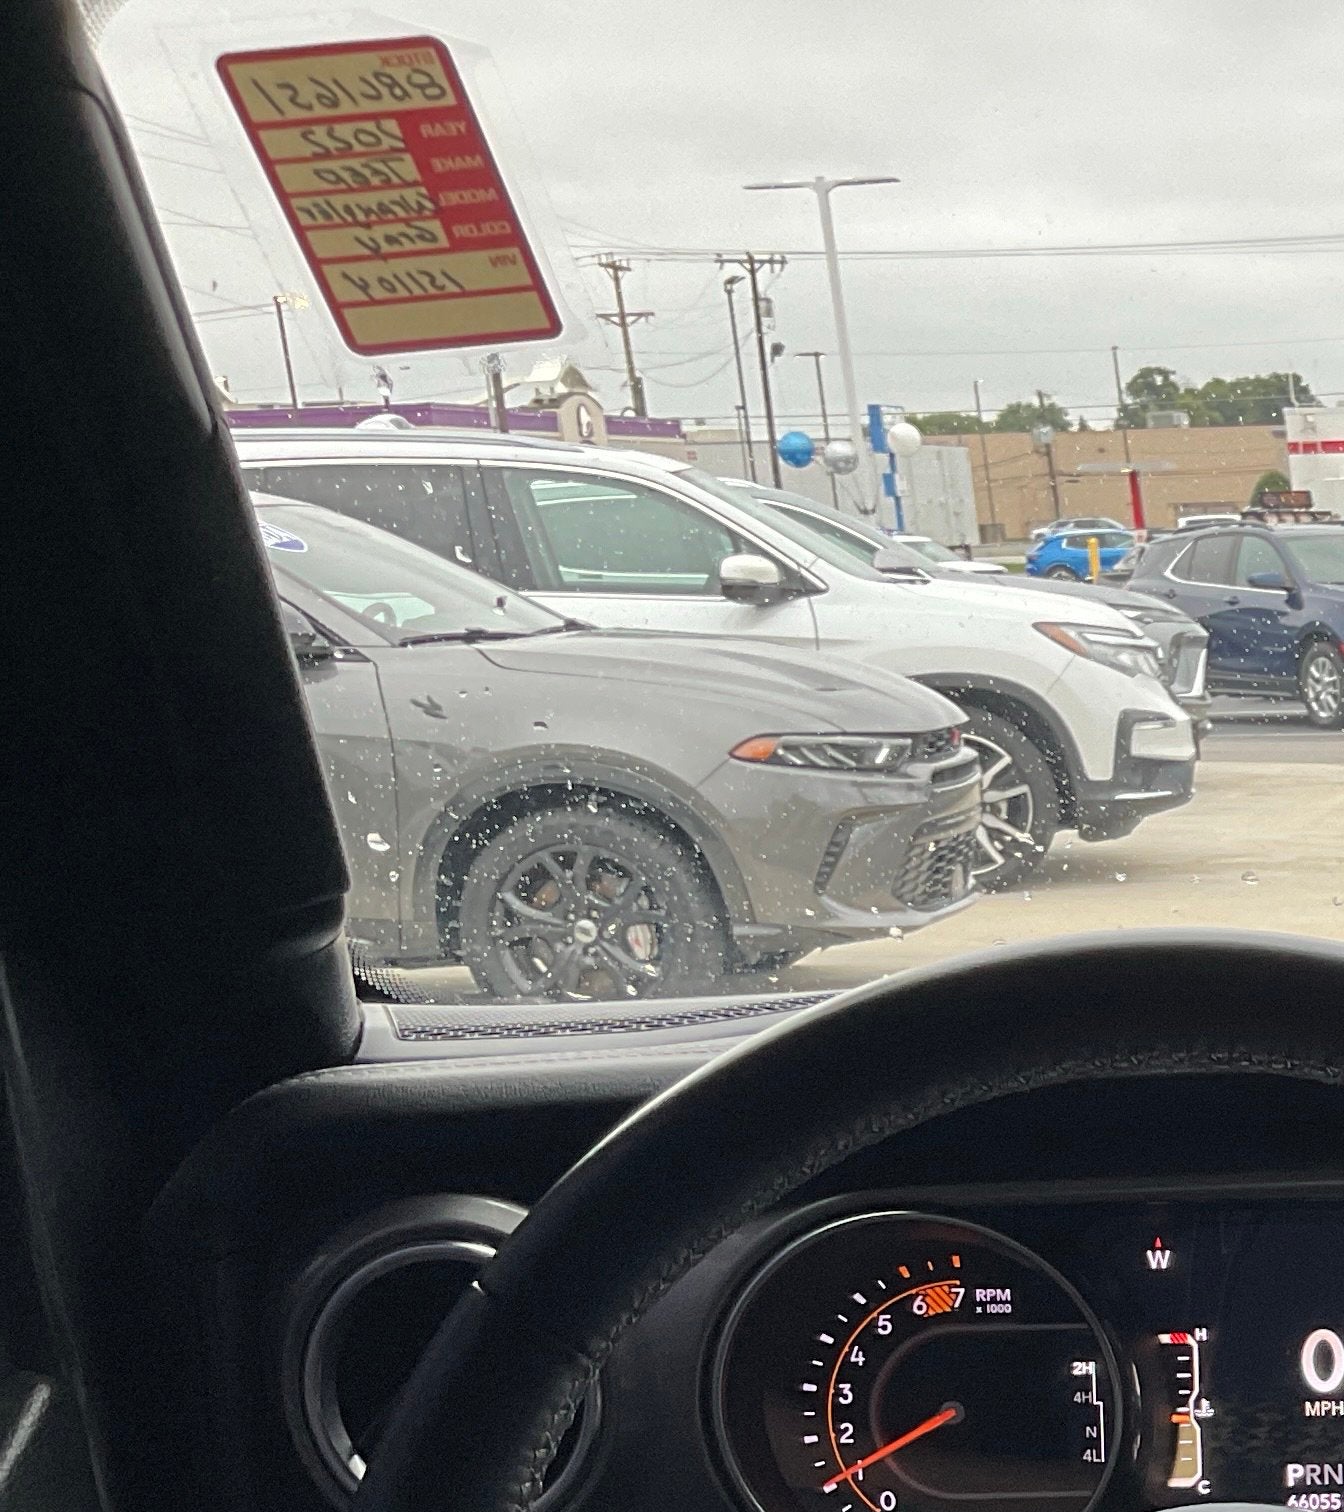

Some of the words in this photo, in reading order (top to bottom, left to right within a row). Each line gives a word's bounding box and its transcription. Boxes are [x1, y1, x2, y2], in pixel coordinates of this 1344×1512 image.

[1146, 1249, 1171, 1270] W
[951, 1288, 965, 1309] 7
[975, 1288, 1011, 1303] RPM
[913, 1296, 927, 1315] 6
[986, 1303, 1012, 1314] 1000
[877, 1314, 892, 1335] 5
[1194, 1327, 1207, 1341] H
[850, 1346, 865, 1366] 4
[1072, 1361, 1095, 1376] 2H
[838, 1383, 853, 1404] 3
[1073, 1391, 1092, 1403] 4H
[1304, 1401, 1344, 1417] MPH
[839, 1423, 854, 1443] 2
[1085, 1426, 1097, 1438] N
[1082, 1449, 1102, 1463] 4L
[1198, 1479, 1211, 1495] C
[880, 1491, 896, 1511] 0
[1288, 1493, 1341, 1510] 66055
